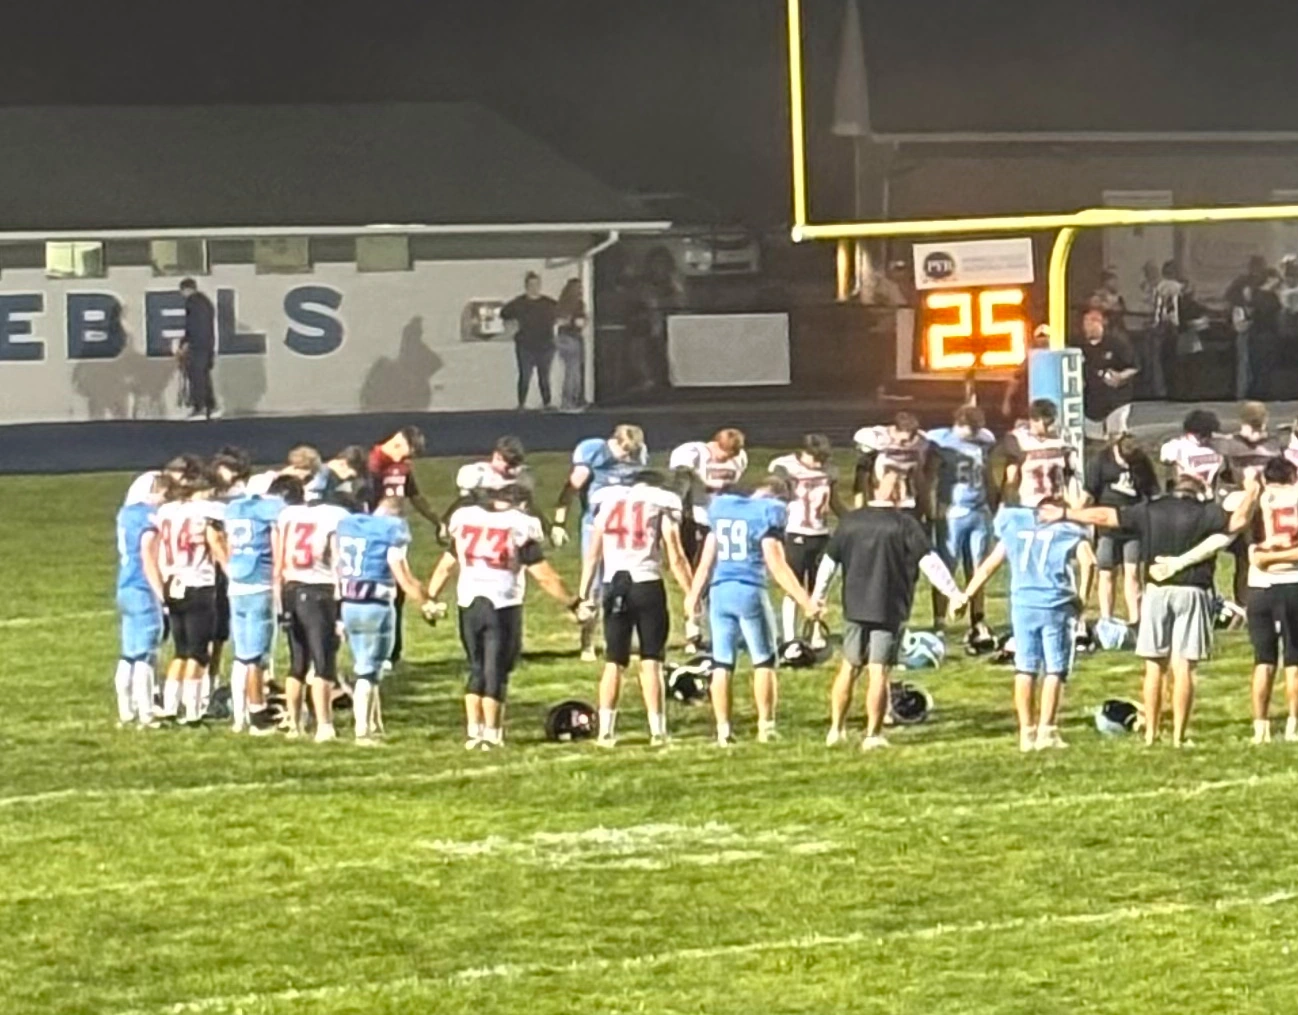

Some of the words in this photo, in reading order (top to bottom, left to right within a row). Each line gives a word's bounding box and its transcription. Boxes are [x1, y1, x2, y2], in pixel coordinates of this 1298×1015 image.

[926, 288, 1026, 370] 25
[603, 498, 649, 551] 41
[715, 518, 749, 561] 59
[1015, 530, 1055, 573] 77
